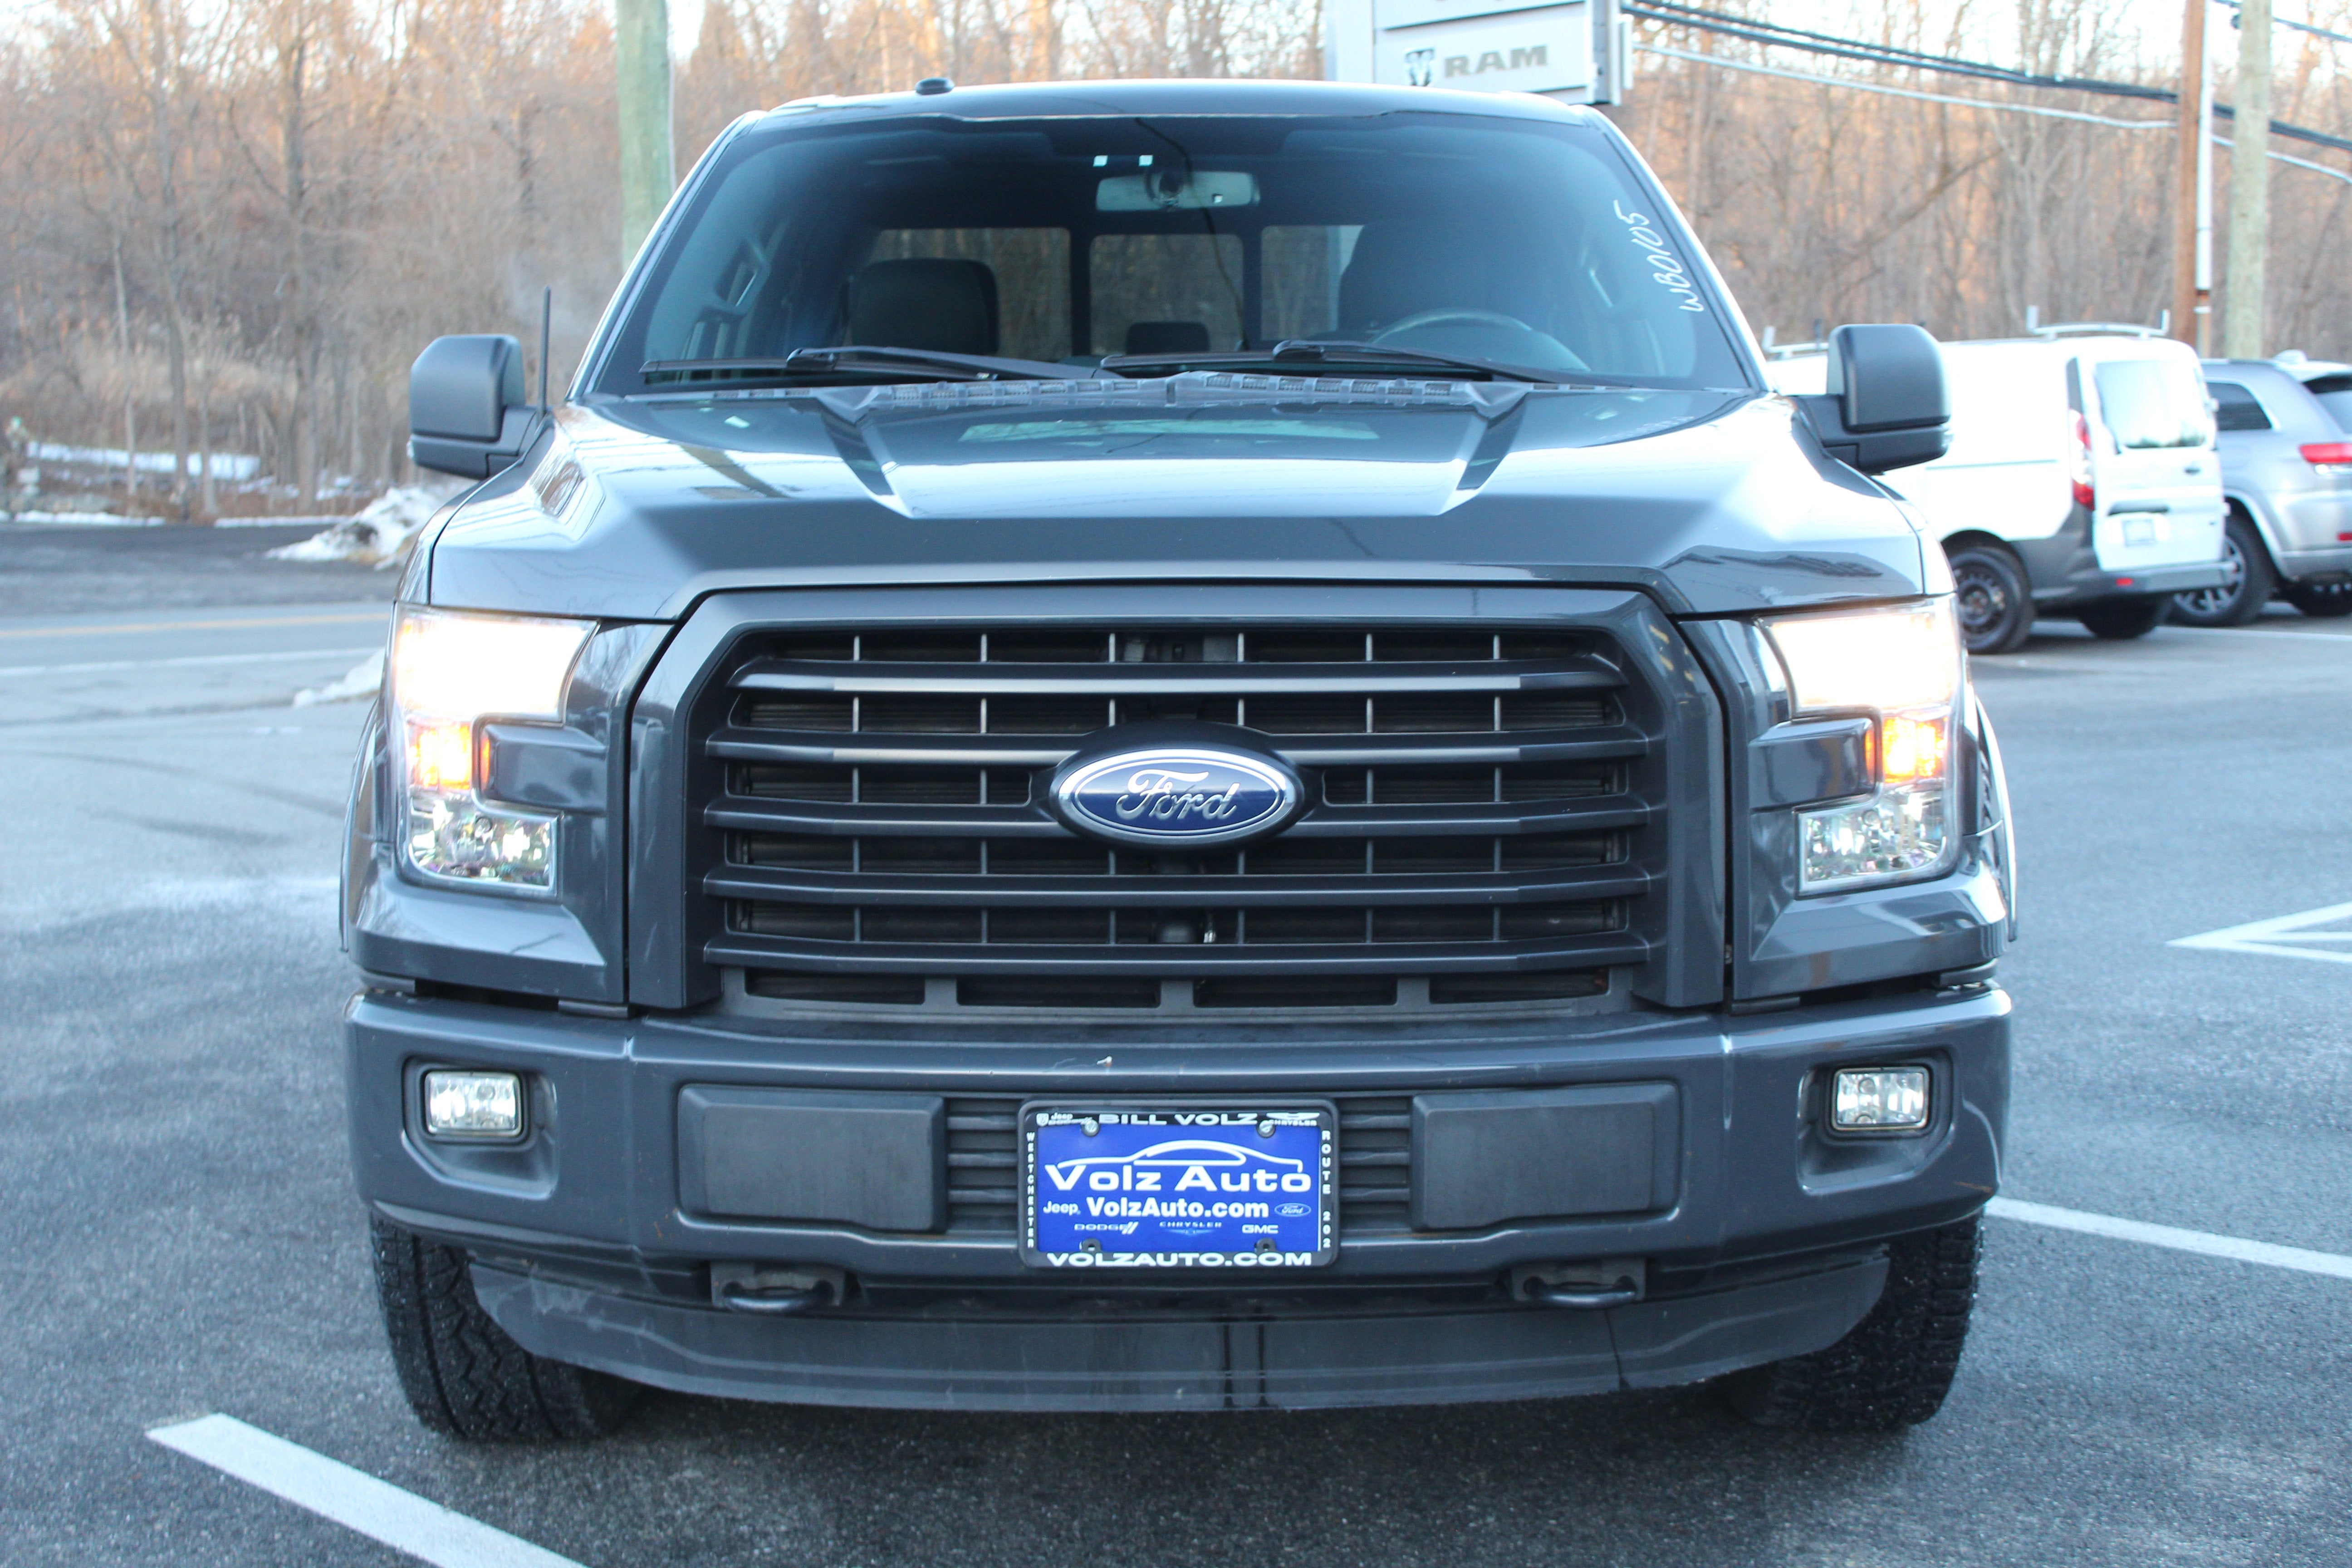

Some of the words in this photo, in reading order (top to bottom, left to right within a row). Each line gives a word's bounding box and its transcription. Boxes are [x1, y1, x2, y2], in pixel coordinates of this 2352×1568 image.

[1443, 45, 1548, 78] RAM
[1115, 769, 1240, 820] Ford
[1098, 1113, 1166, 1125] BILL
[1174, 1113, 1258, 1126] VOLZ
[1321, 1130, 1332, 1195] ROUTE
[1026, 1132, 1035, 1248] WESTCHESTER
[1044, 1164, 1162, 1191] Volz
[1174, 1165, 1312, 1192] Auto
[1043, 1200, 1079, 1215] Jeep
[1086, 1196, 1269, 1218] VolzAuto.com
[1281, 1205, 1303, 1214] Ford
[1242, 1224, 1279, 1234] GMC
[1322, 1210, 1331, 1248] 202
[1047, 1252, 1312, 1266] VOLZAUTO.COM
